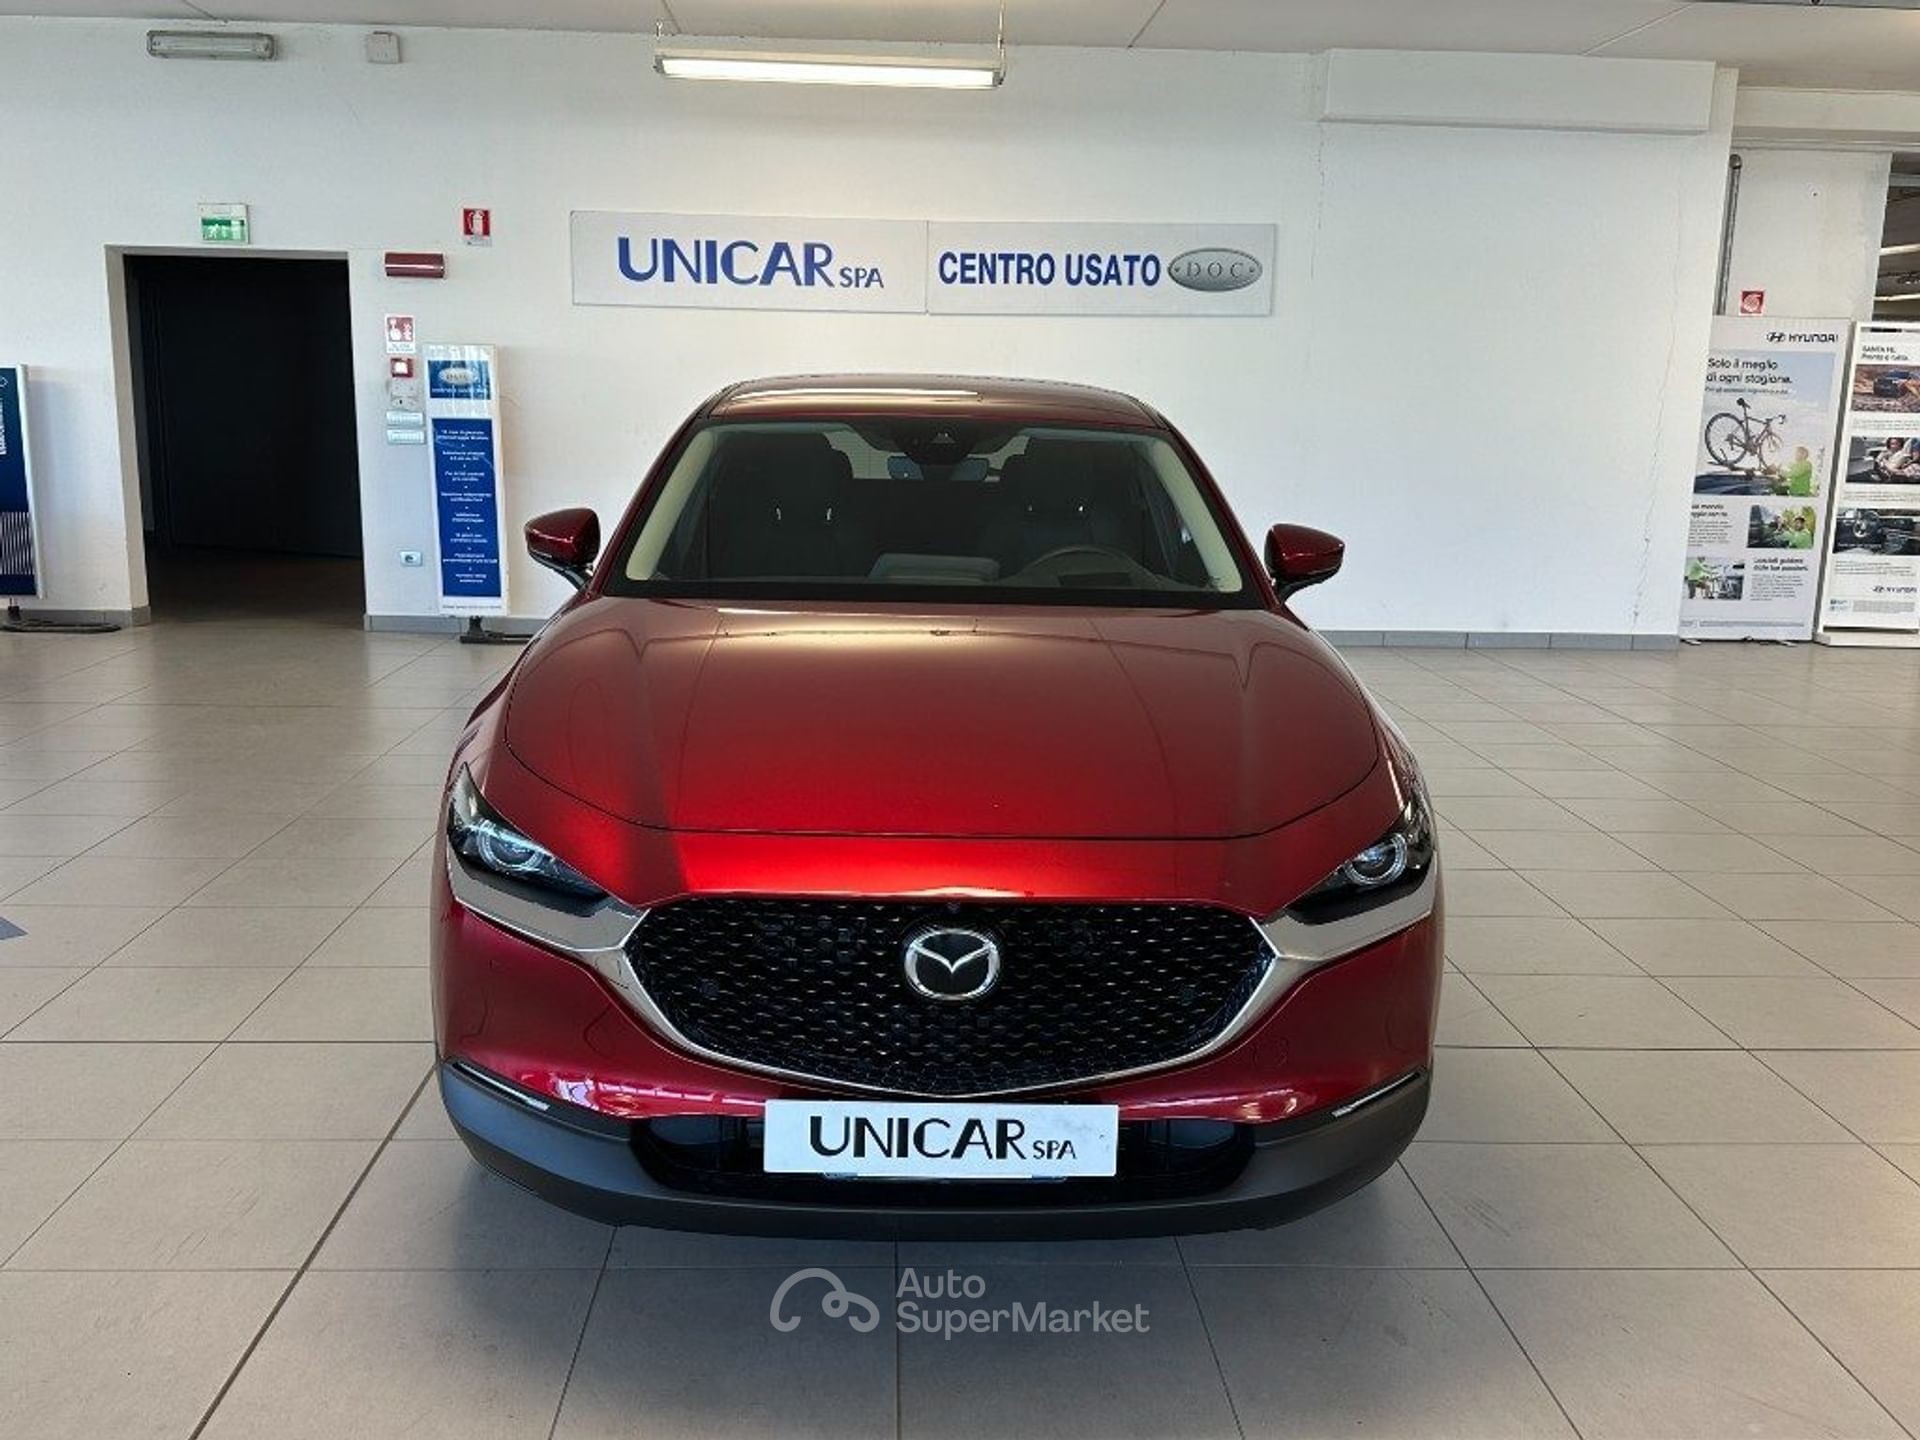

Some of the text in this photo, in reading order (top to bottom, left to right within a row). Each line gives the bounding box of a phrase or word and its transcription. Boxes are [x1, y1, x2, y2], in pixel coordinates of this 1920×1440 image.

[617, 236, 885, 289] UNICAR SPA
[938, 251, 1056, 285] CENTRO
[1064, 253, 1162, 286] USATO
[1788, 331, 1839, 343] HYUNDAI
[1707, 358, 1732, 369] Solo
[1741, 359, 1779, 372] meglio
[1719, 372, 1742, 384] ogni
[1745, 373, 1794, 386] stagione.
[809, 1115, 1077, 1160] UNICAR SPA
